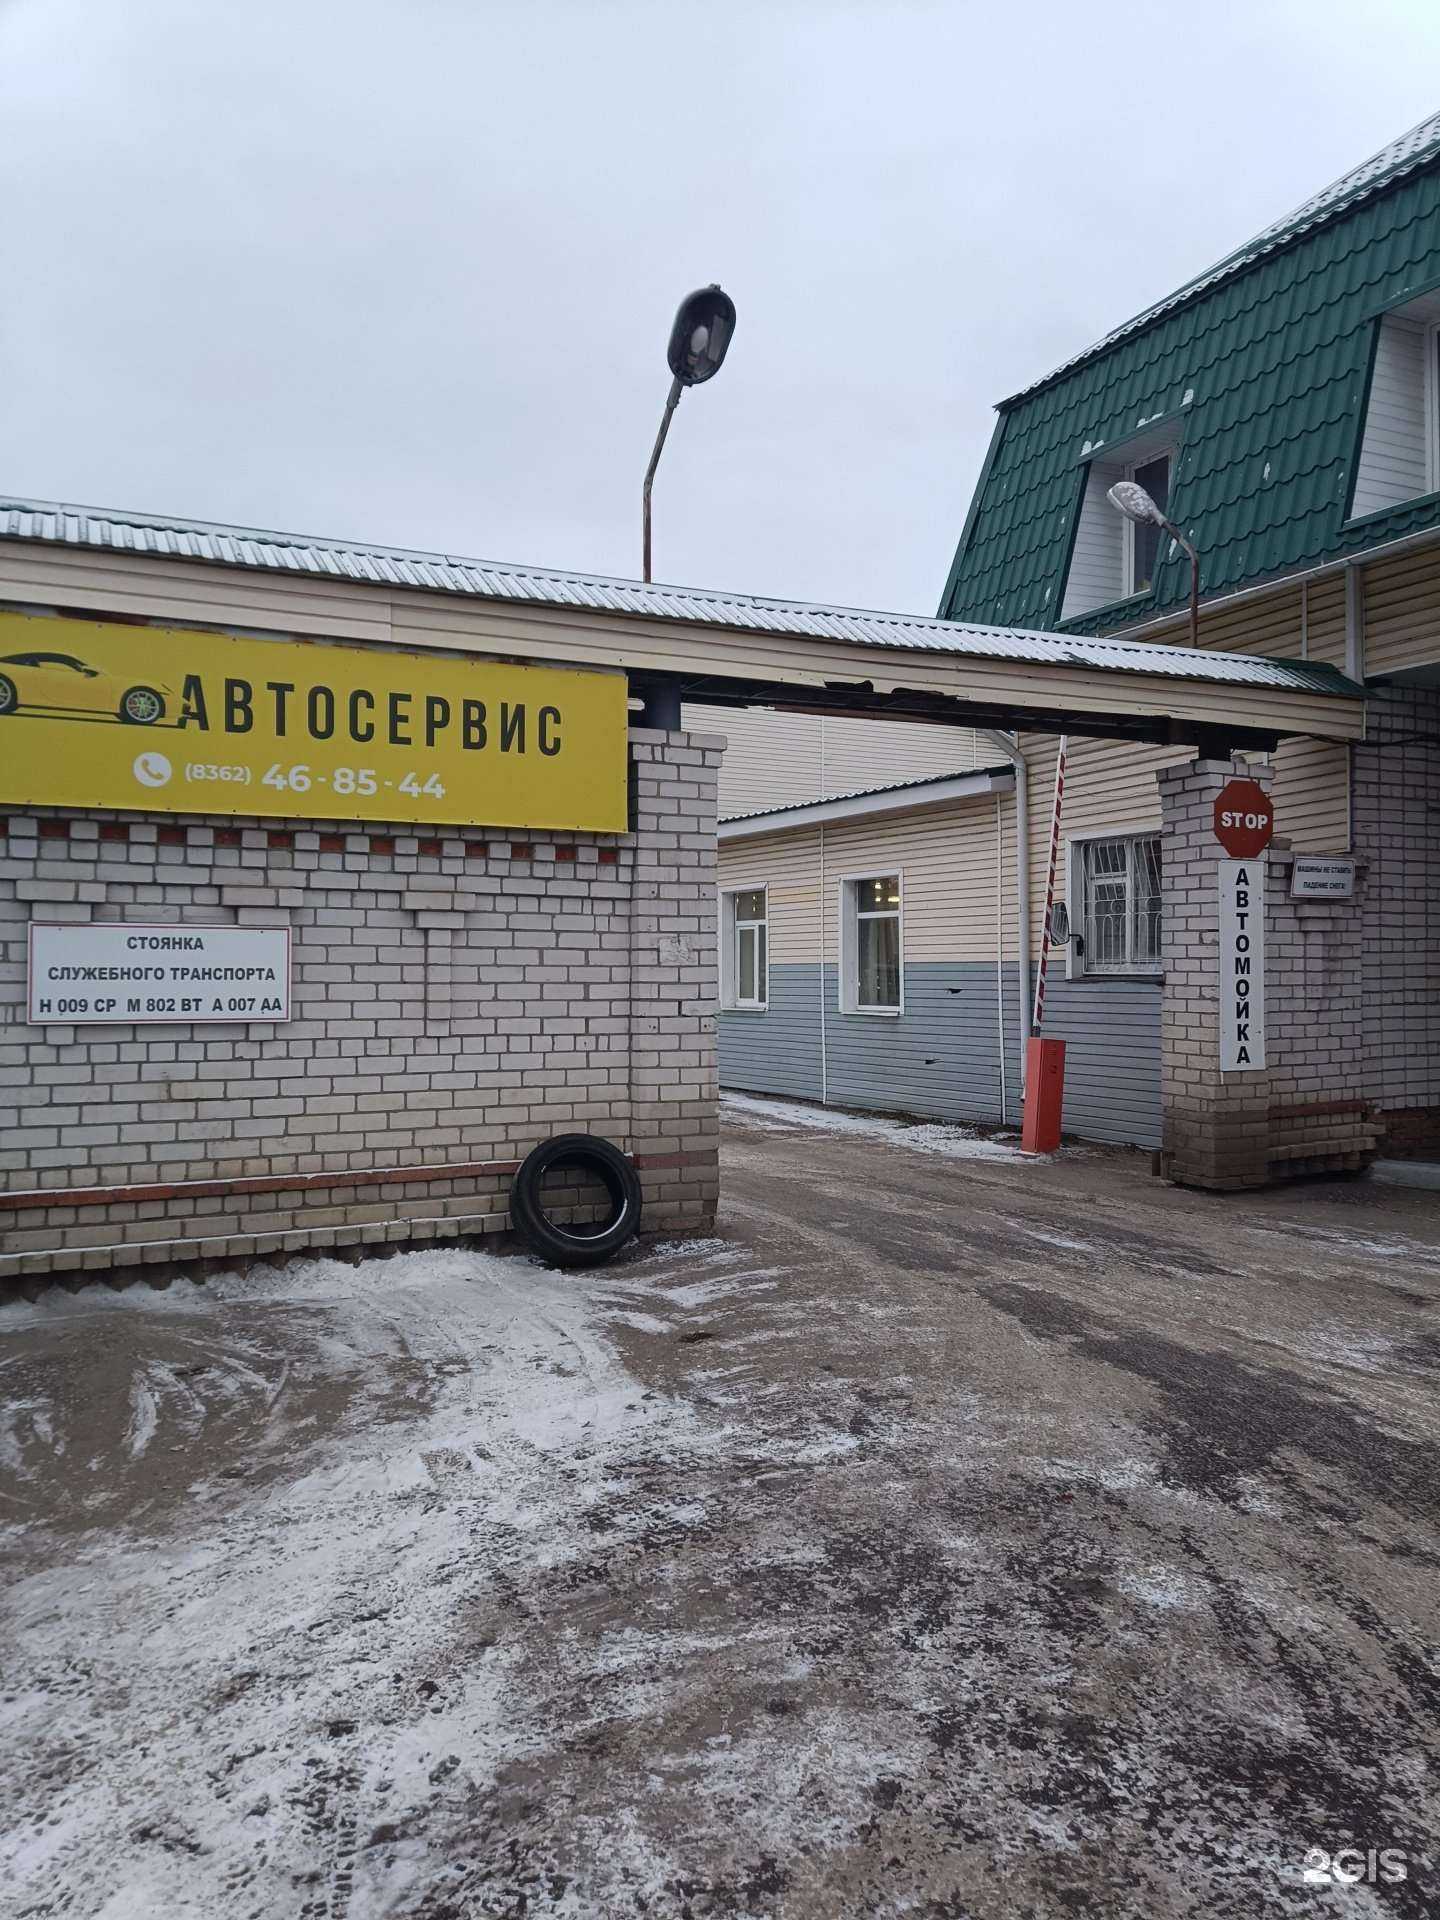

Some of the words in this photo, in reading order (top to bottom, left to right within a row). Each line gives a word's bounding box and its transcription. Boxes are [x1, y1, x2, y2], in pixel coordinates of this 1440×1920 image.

[179, 674, 561, 757] АВТОСЕРВИС
[185, 763, 251, 785] (8362)
[1221, 811, 1268, 829] STOP
[126, 936, 204, 950] СТОЯНКА
[48, 966, 165, 981] СЛУЖЕБНОГО
[170, 966, 275, 981] ТРАНСПОРТА
[1234, 868, 1251, 1064] АВТОМОЙКА
[39, 999, 51, 1013] Н
[57, 999, 88, 1013] 009
[94, 999, 117, 1013] СР
[127, 998, 141, 1012] М
[146, 998, 176, 1012] 802
[181, 998, 203, 1012] ВТ
[212, 998, 223, 1012] А
[228, 998, 256, 1012] 007
[261, 998, 282, 1011] АА
